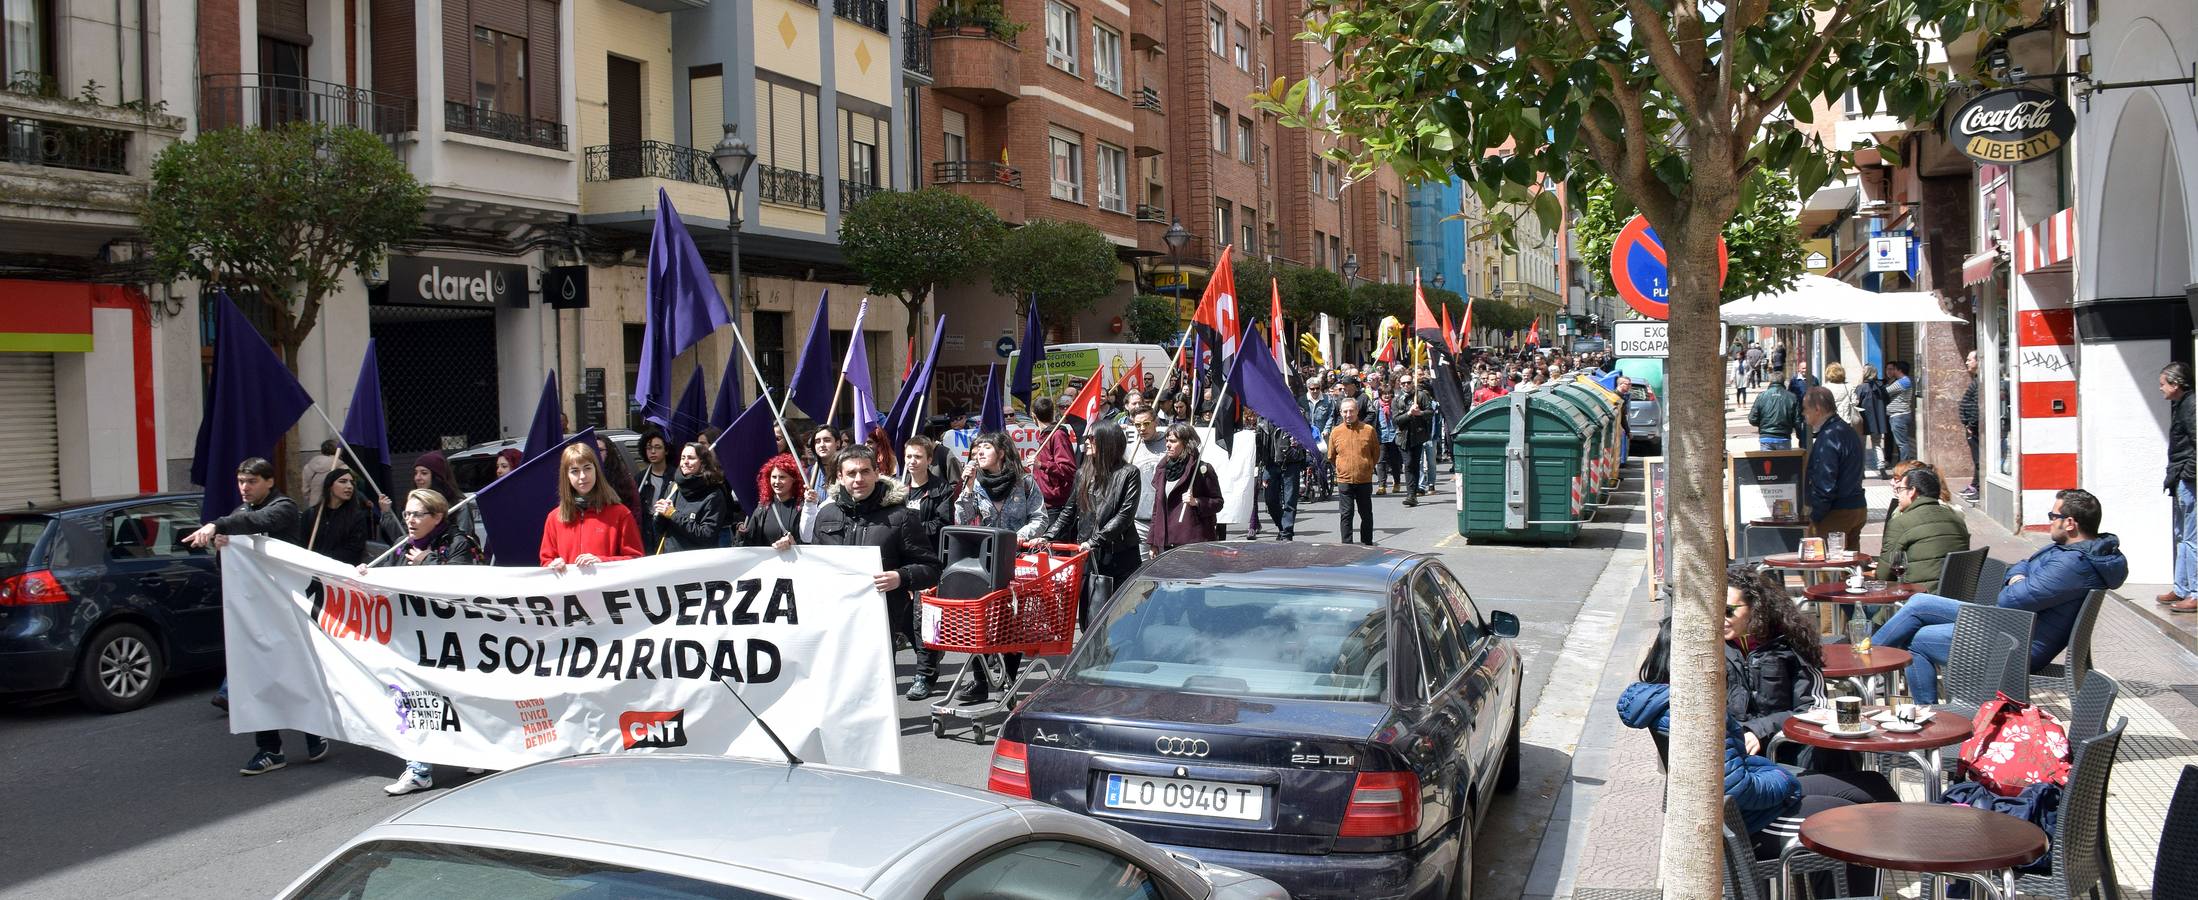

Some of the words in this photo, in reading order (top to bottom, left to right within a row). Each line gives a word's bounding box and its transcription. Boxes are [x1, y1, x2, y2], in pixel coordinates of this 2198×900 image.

[1960, 99, 2056, 135] Coca-Cola
[1972, 133, 2051, 159] LIBERTY
[418, 265, 494, 303] clarel
[1653, 288, 1669, 297] PLA
[1644, 327, 1669, 338] EXC
[1621, 341, 1669, 352] DISCAPA
[399, 593, 596, 627] NUESTRA
[601, 578, 799, 626] FUERZA
[416, 630, 466, 672] LA
[476, 632, 782, 685] SOLIDARIDAD
[515, 698, 545, 709] CENTRO
[523, 719, 554, 736] MADRE
[629, 721, 678, 743] CNT
[1033, 727, 1059, 743] A4
[1163, 782, 1228, 813] 0940
[1236, 788, 1251, 814] T
